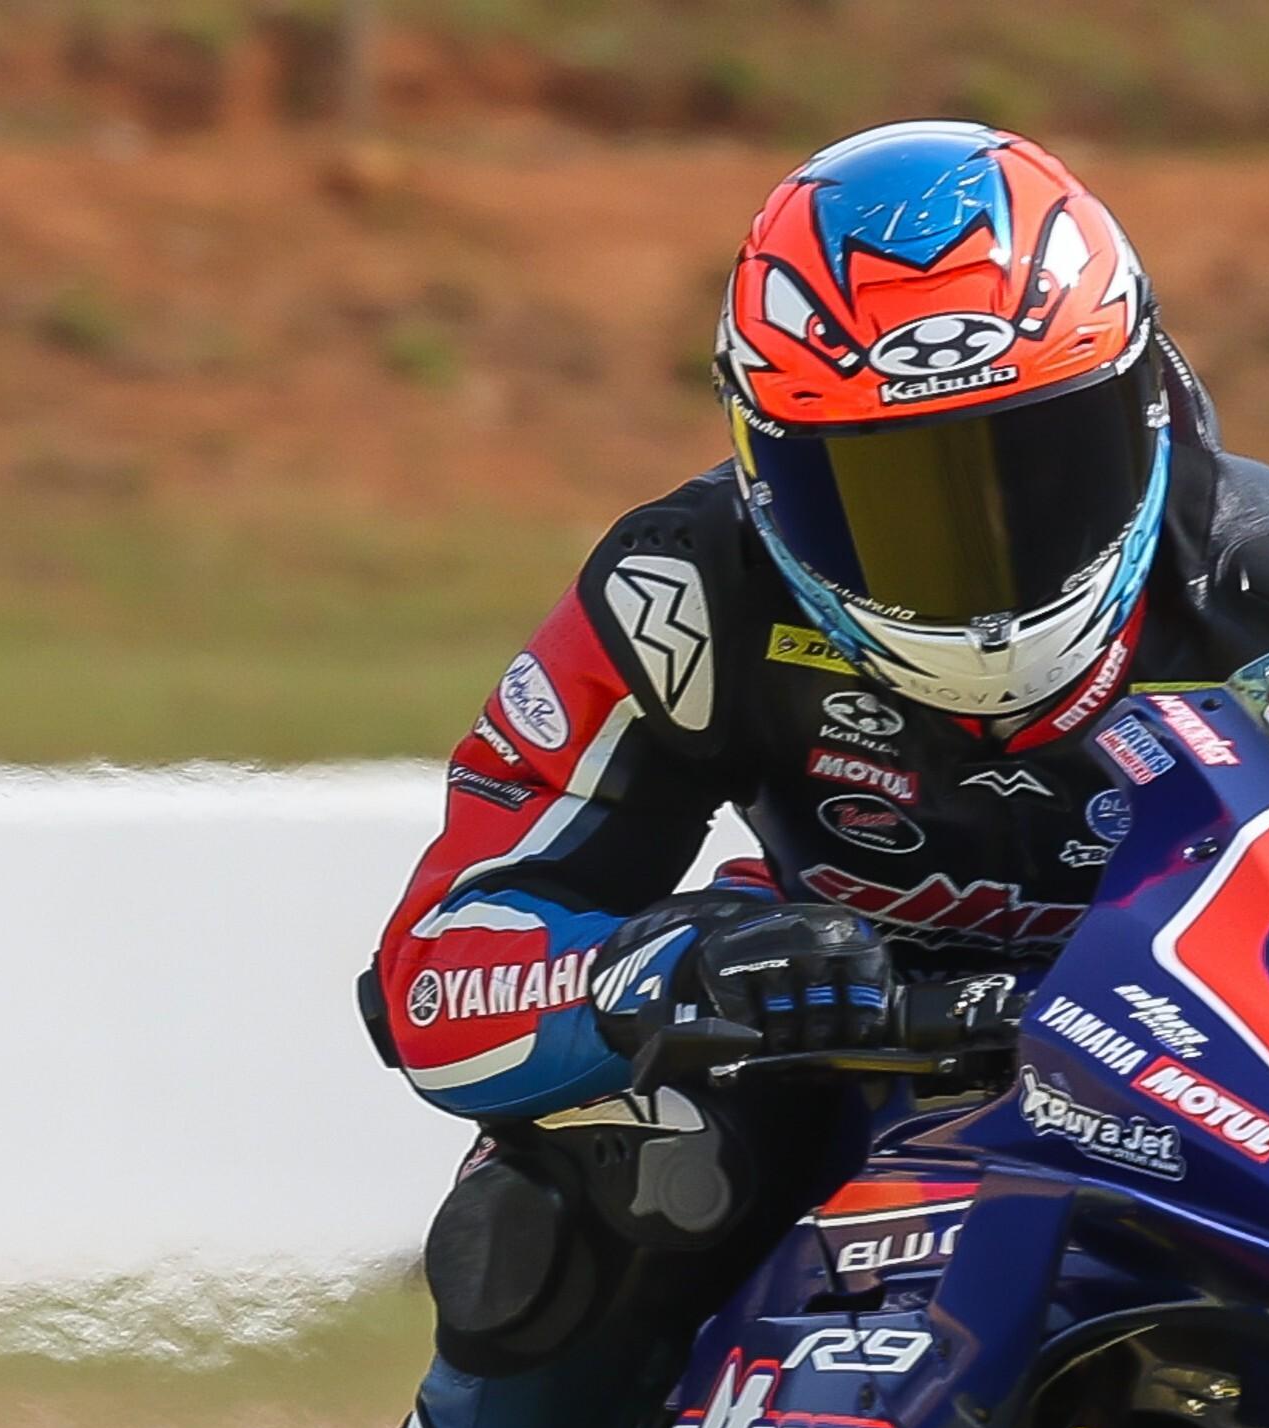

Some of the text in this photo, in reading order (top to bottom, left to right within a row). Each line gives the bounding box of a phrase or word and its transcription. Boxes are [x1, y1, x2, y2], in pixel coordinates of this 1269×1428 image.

[881, 365, 1018, 402] Kabuto
[811, 754, 912, 799] MOTUL
[1038, 996, 1148, 1075] YAMAHA
[781, 1328, 934, 1373] R9
